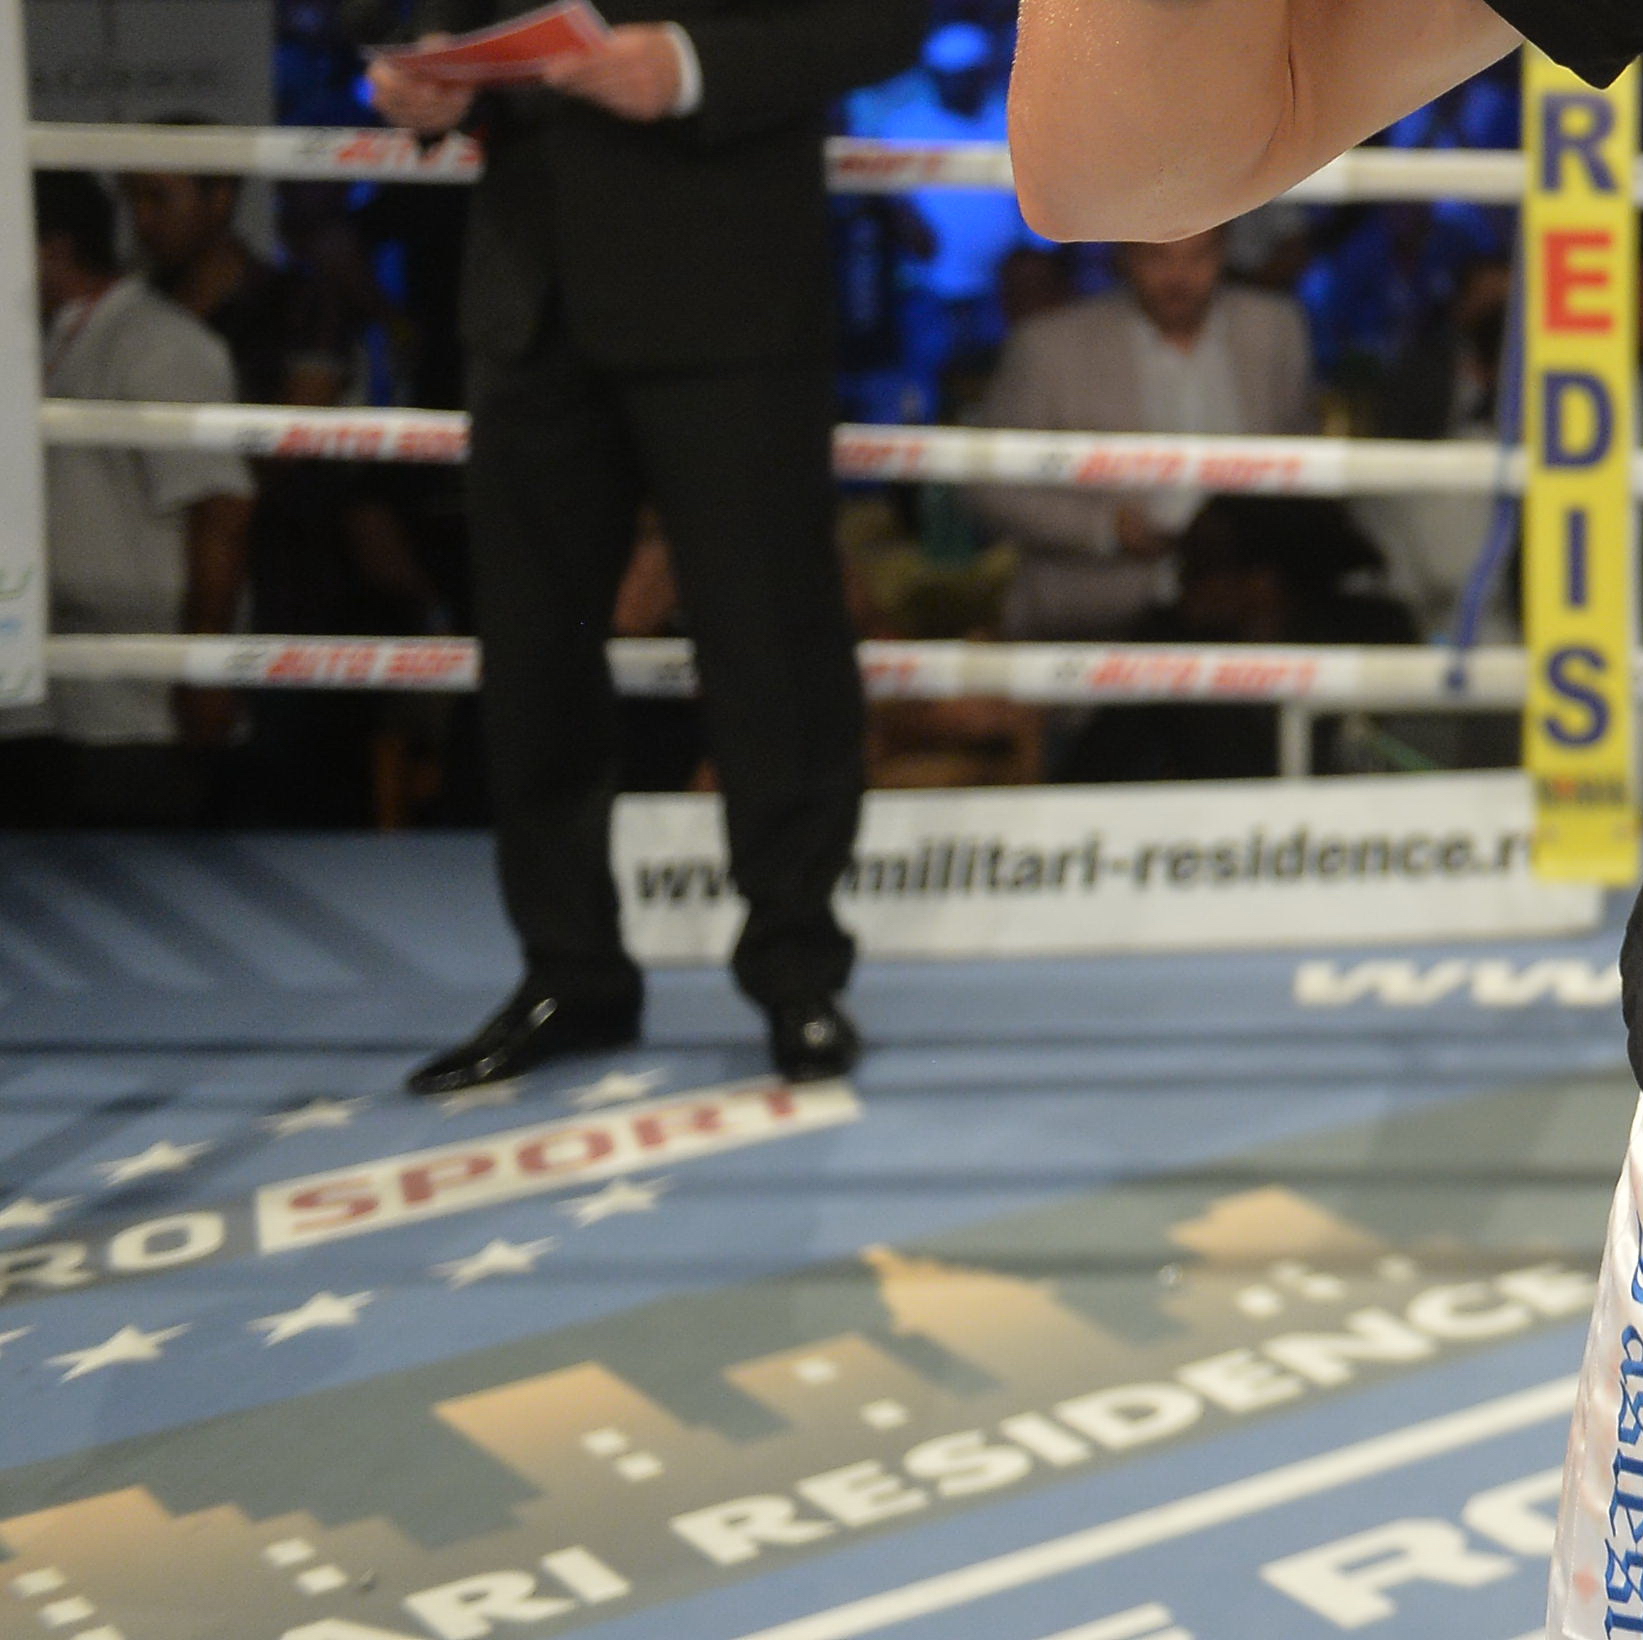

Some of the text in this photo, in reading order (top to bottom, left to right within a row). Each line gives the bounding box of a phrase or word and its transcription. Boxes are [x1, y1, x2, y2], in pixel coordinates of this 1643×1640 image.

[285, 1082, 802, 1235] SPORT
[280, 1259, 1601, 1640] RI RESIDENCE
